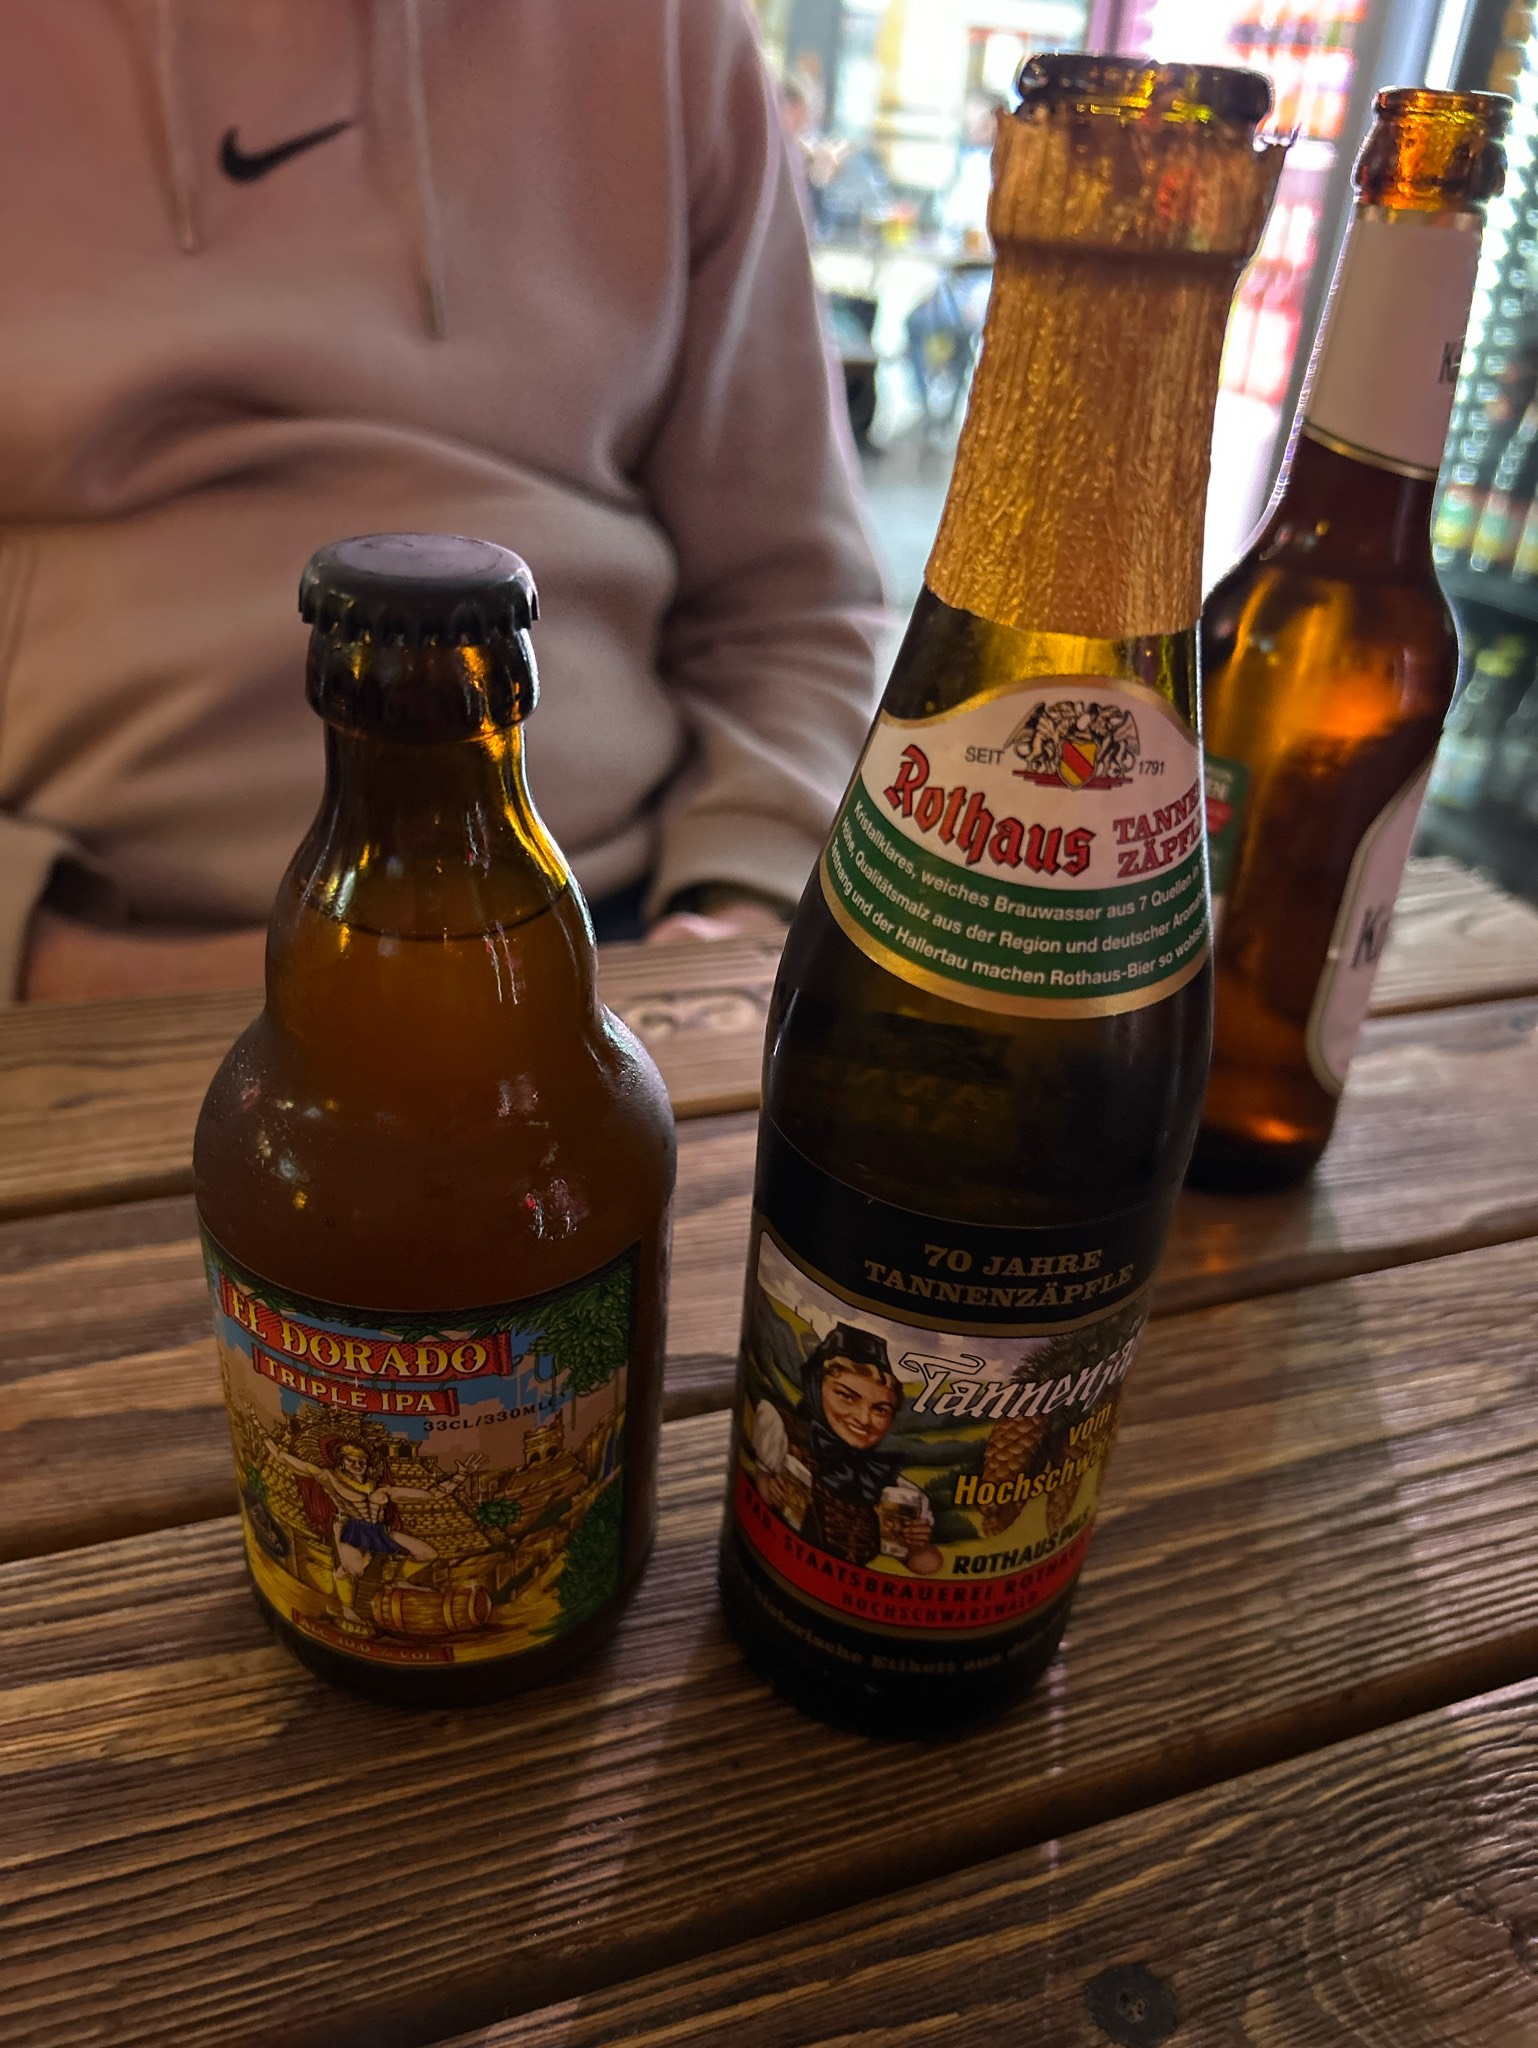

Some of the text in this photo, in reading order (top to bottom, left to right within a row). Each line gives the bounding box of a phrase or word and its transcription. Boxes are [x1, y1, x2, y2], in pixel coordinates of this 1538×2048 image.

[964, 747, 1005, 766] SEIT
[1138, 761, 1165, 776] 1791
[883, 743, 1097, 878] Rothaus
[1112, 779, 1201, 846] TANNE
[854, 801, 916, 879] Kristallklares,
[921, 870, 990, 908] weiches
[993, 895, 1102, 921] Brauwasser
[1107, 902, 1135, 918] aus
[1139, 896, 1148, 911] 7
[1151, 874, 1192, 907] Quellen
[1117, 813, 1203, 879] ZÄPFL
[831, 836, 853, 896] Tettnang
[852, 890, 874, 917] und
[872, 912, 894, 934] der
[895, 926, 968, 970] Hallertau
[972, 960, 1045, 985] machen
[1050, 959, 1156, 986] Rothaus-Bier
[1158, 952, 1173, 967] so
[855, 851, 931, 922] Qualitätsmalz
[932, 913, 962, 934] aus
[966, 924, 996, 943] der
[999, 930, 1061, 954] Region
[1066, 937, 1098, 954] und
[1102, 922, 1170, 951] deutscher
[864, 1260, 1135, 1307] TANNENZÄPFLE
[924, 1243, 1103, 1277] 70 JAHRE
[231, 1288, 488, 1377] EL DORADO
[264, 1356, 437, 1412] TRIPLE IPA
[1069, 1403, 1112, 1446] vom
[783, 1533, 994, 1603] STAATSBRAUEREI
[952, 1533, 1058, 1575] ROTHAUS
[841, 1591, 1038, 1624] HOCHSCHWARZWALD
